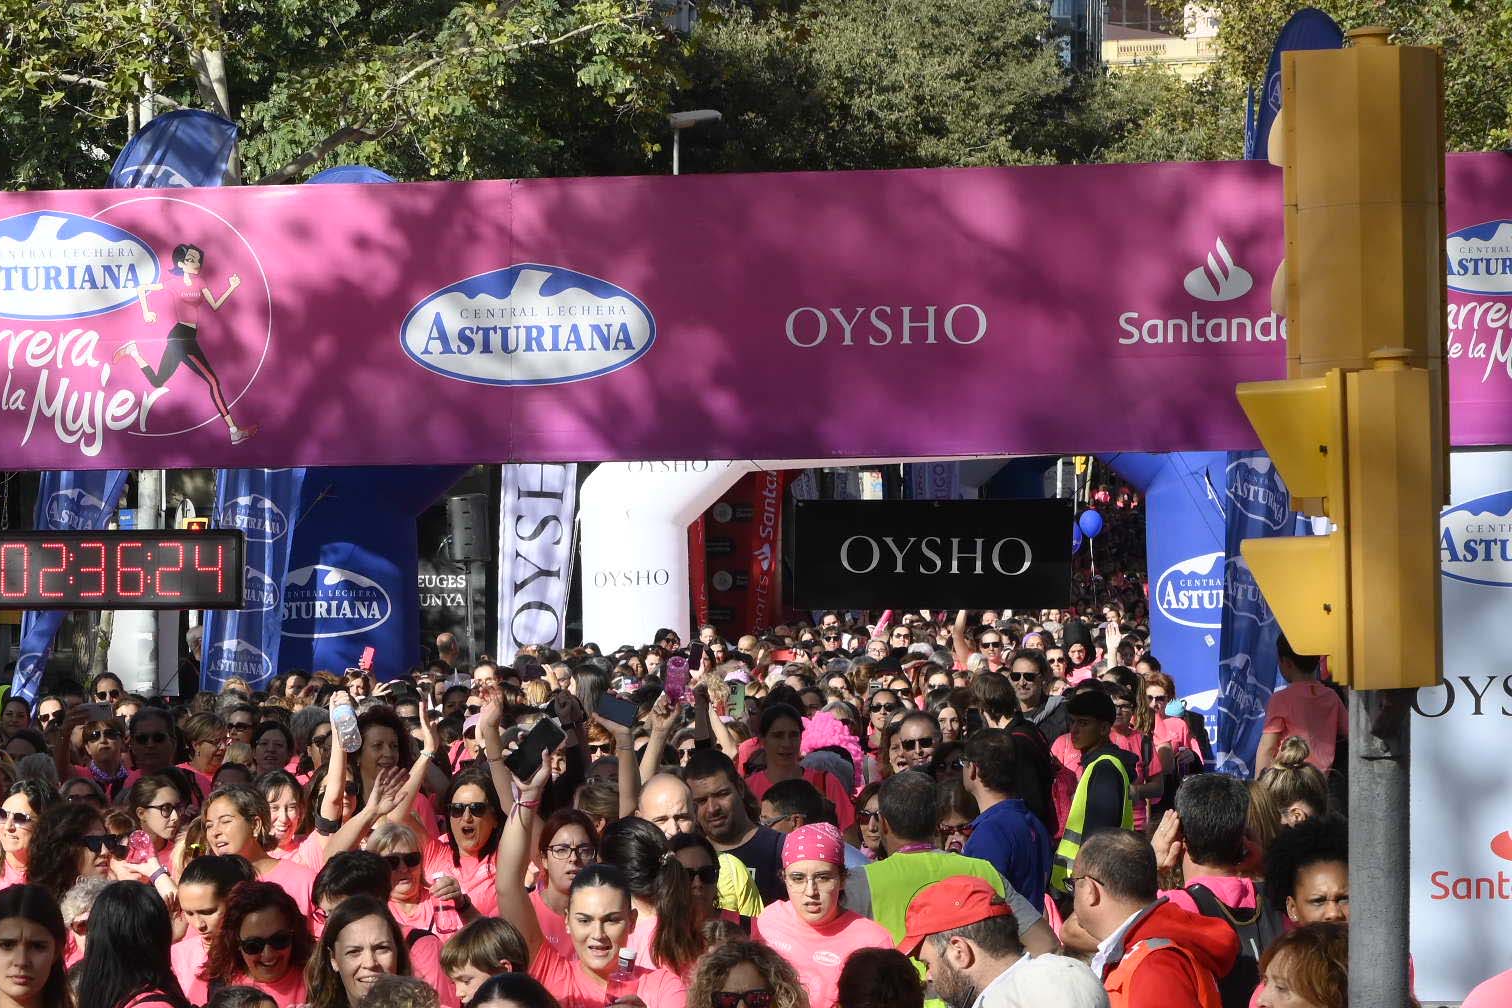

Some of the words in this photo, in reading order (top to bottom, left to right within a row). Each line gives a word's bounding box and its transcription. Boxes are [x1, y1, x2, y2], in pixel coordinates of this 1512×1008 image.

[63, 248, 136, 258] LECHERA
[460, 308, 537, 320] CENTRAL
[546, 305, 625, 317] LECHERA
[785, 303, 987, 348] OYSHO
[421, 311, 636, 356] ASTURIANA
[1468, 330, 1486, 359] la
[1, 370, 26, 411] la
[21, 362, 170, 456] Mujer
[0, 543, 223, 597] 02:36:24
[840, 535, 1033, 576] OYSHO
[594, 569, 670, 588] OYSHO
[1180, 579, 1223, 588] CENTRA
[282, 600, 382, 620] STURIANA
